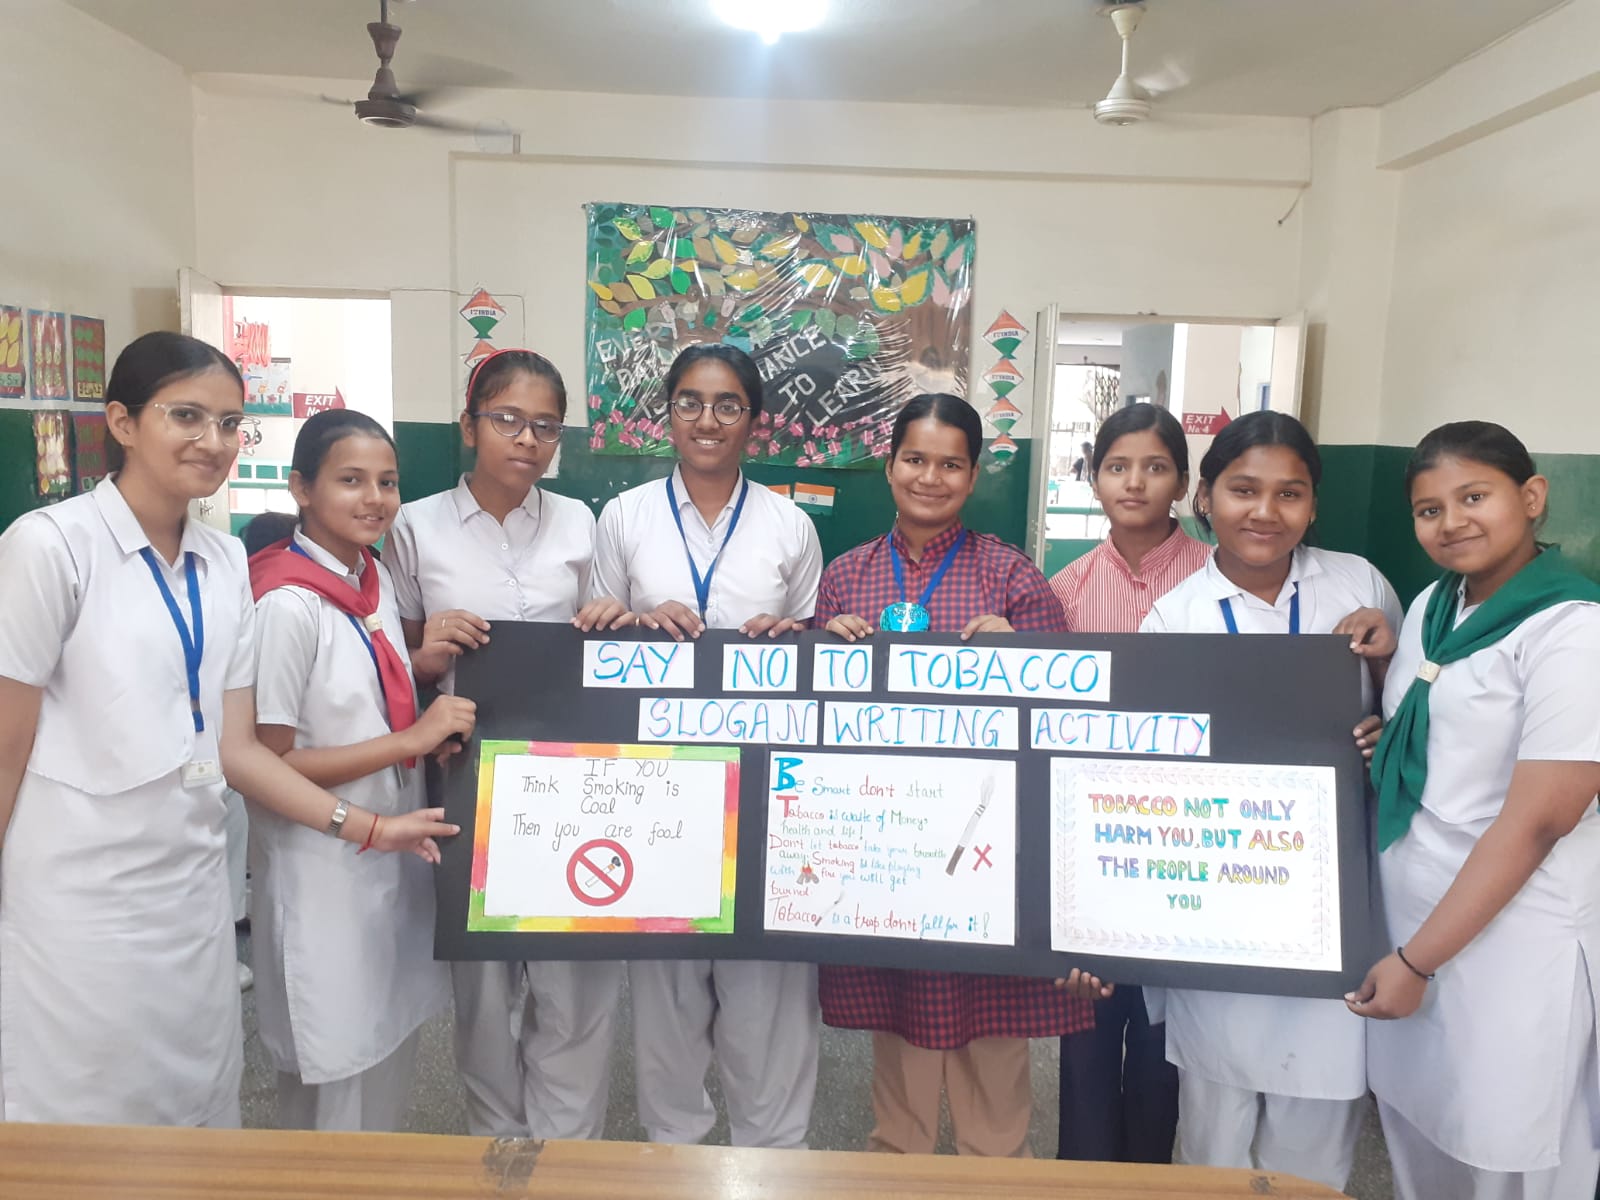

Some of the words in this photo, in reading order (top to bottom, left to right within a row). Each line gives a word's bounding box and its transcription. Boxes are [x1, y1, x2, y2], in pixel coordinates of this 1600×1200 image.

[304, 395, 337, 406] EXIT
[778, 373, 816, 405] TO
[805, 356, 881, 427] LEARN
[1185, 415, 1216, 425] EXIT
[594, 642, 680, 684] SAY
[732, 648, 788, 688] NO
[819, 649, 868, 689] TO
[899, 649, 1099, 693] TOBACCO
[648, 698, 816, 743] SLOGAN
[833, 705, 1004, 747] WRITING
[1035, 711, 1209, 756] ACTIVITY
[584, 759, 617, 777] IF
[635, 760, 669, 778] YOU
[522, 775, 559, 794] Think
[583, 777, 645, 805] Smoking
[666, 780, 679, 797] is
[812, 777, 851, 796] Smart
[859, 774, 895, 798] don't
[906, 780, 944, 799] start
[1088, 794, 1178, 816] TOBACCO
[1184, 798, 1229, 818] NOT
[1239, 799, 1296, 821] ONLY
[513, 813, 540, 836] Then
[552, 821, 580, 851] you
[604, 824, 633, 839] are
[782, 821, 811, 837] health
[814, 823, 834, 837] and
[875, 809, 886, 832] of
[769, 834, 804, 849] Don't
[1094, 823, 1152, 845] HARM
[1248, 829, 1304, 852] ALSO
[812, 851, 855, 873] Smoking
[1097, 855, 1140, 878] THE
[1147, 859, 1209, 882] PEOPLE
[1217, 863, 1290, 885] AROUND
[890, 876, 907, 891] get
[1167, 894, 1202, 911] YOU
[883, 910, 917, 931] don't
